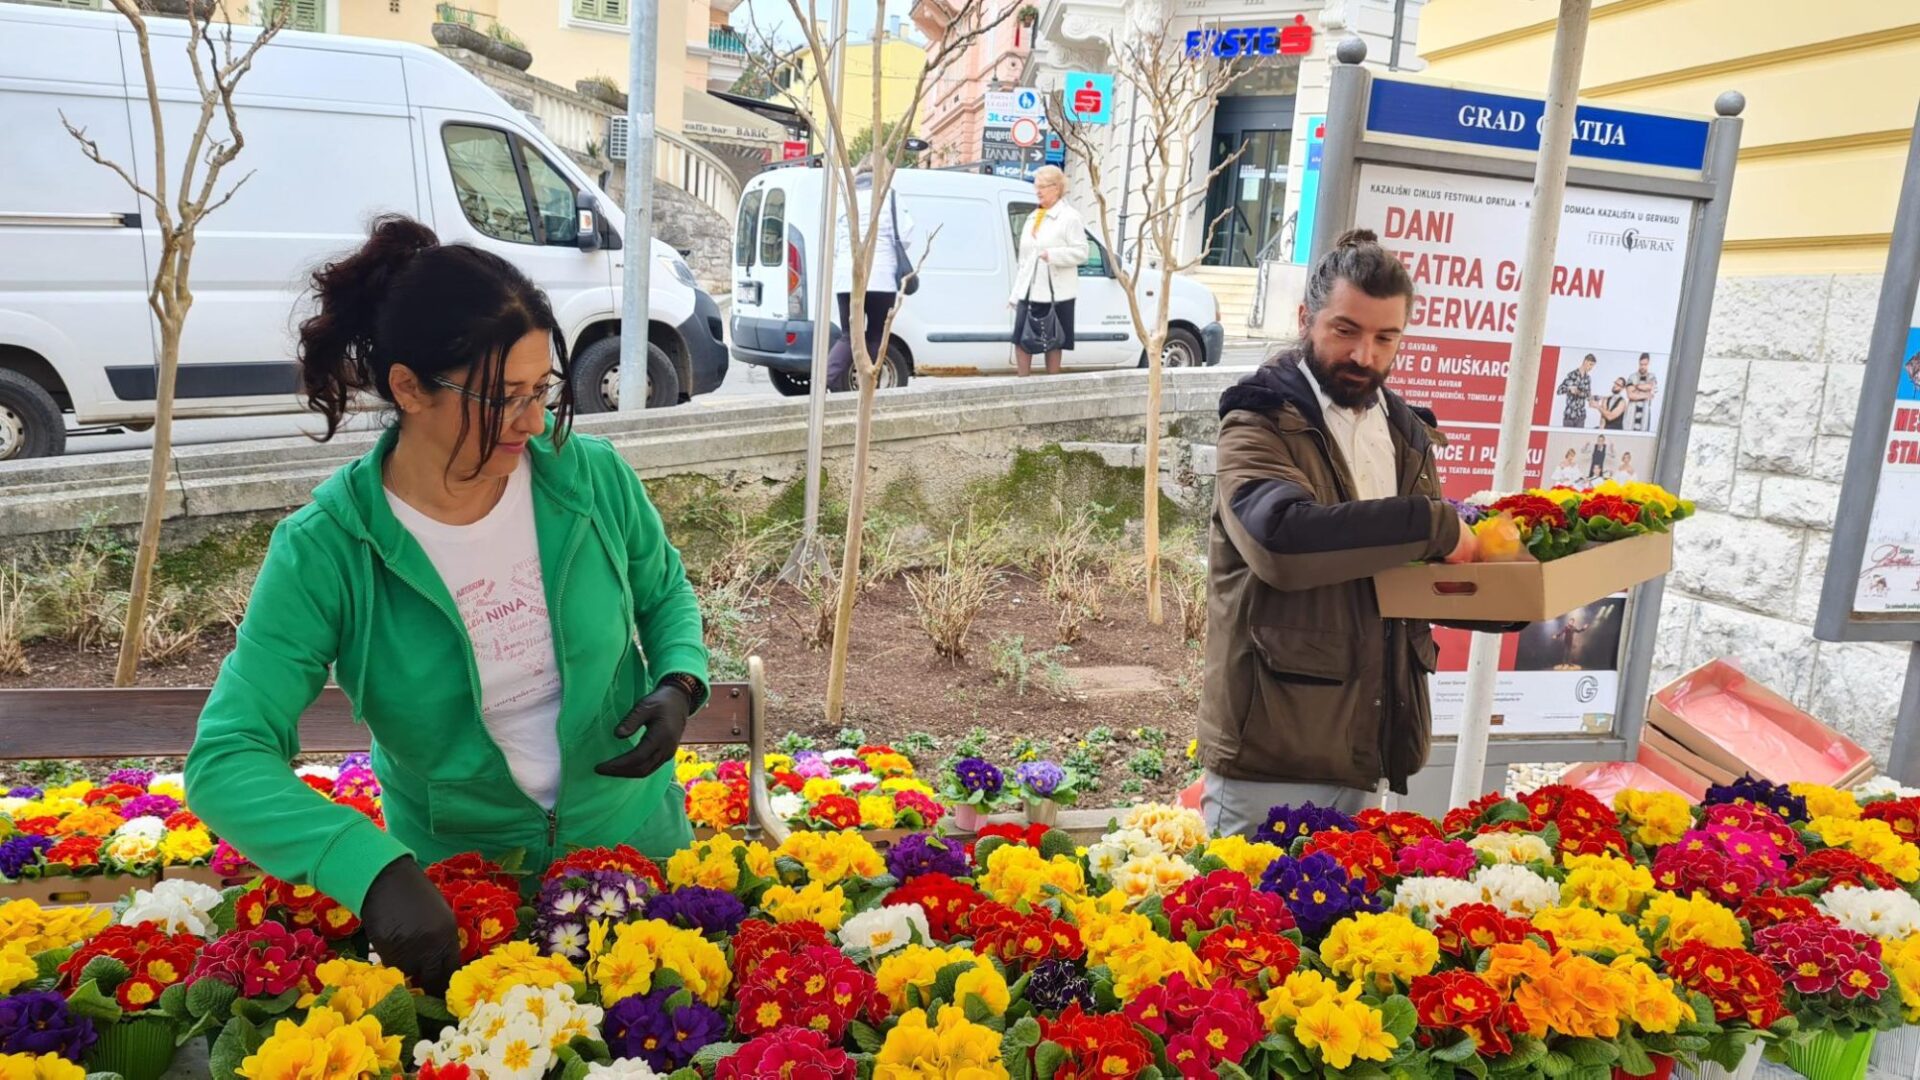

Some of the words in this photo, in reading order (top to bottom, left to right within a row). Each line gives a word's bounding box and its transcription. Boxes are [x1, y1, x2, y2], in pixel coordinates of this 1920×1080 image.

[1185, 26, 1278, 58] ERSTE
[711, 125, 727, 134] bar
[1458, 105, 1526, 132] GRAD
[1370, 184, 1411, 196] KAZALIŠNI
[1413, 188, 1441, 200] CIKLUS
[1444, 191, 1483, 204] FESTIVALA
[1486, 196, 1516, 207] OPATIJA
[1384, 206, 1454, 243] DANI
[1638, 212, 1643, 221] U
[1646, 213, 1680, 225] GERVAISU
[1392, 251, 1484, 289] EATRA
[1409, 295, 1518, 333] GERVAIS
[1420, 356, 1431, 372] O
[1437, 354, 1510, 378] MUŠKARC
[1893, 407, 1920, 432] ME
[1469, 446, 1475, 462] I
[1887, 440, 1920, 464] STA
[485, 598, 527, 623] NINA
